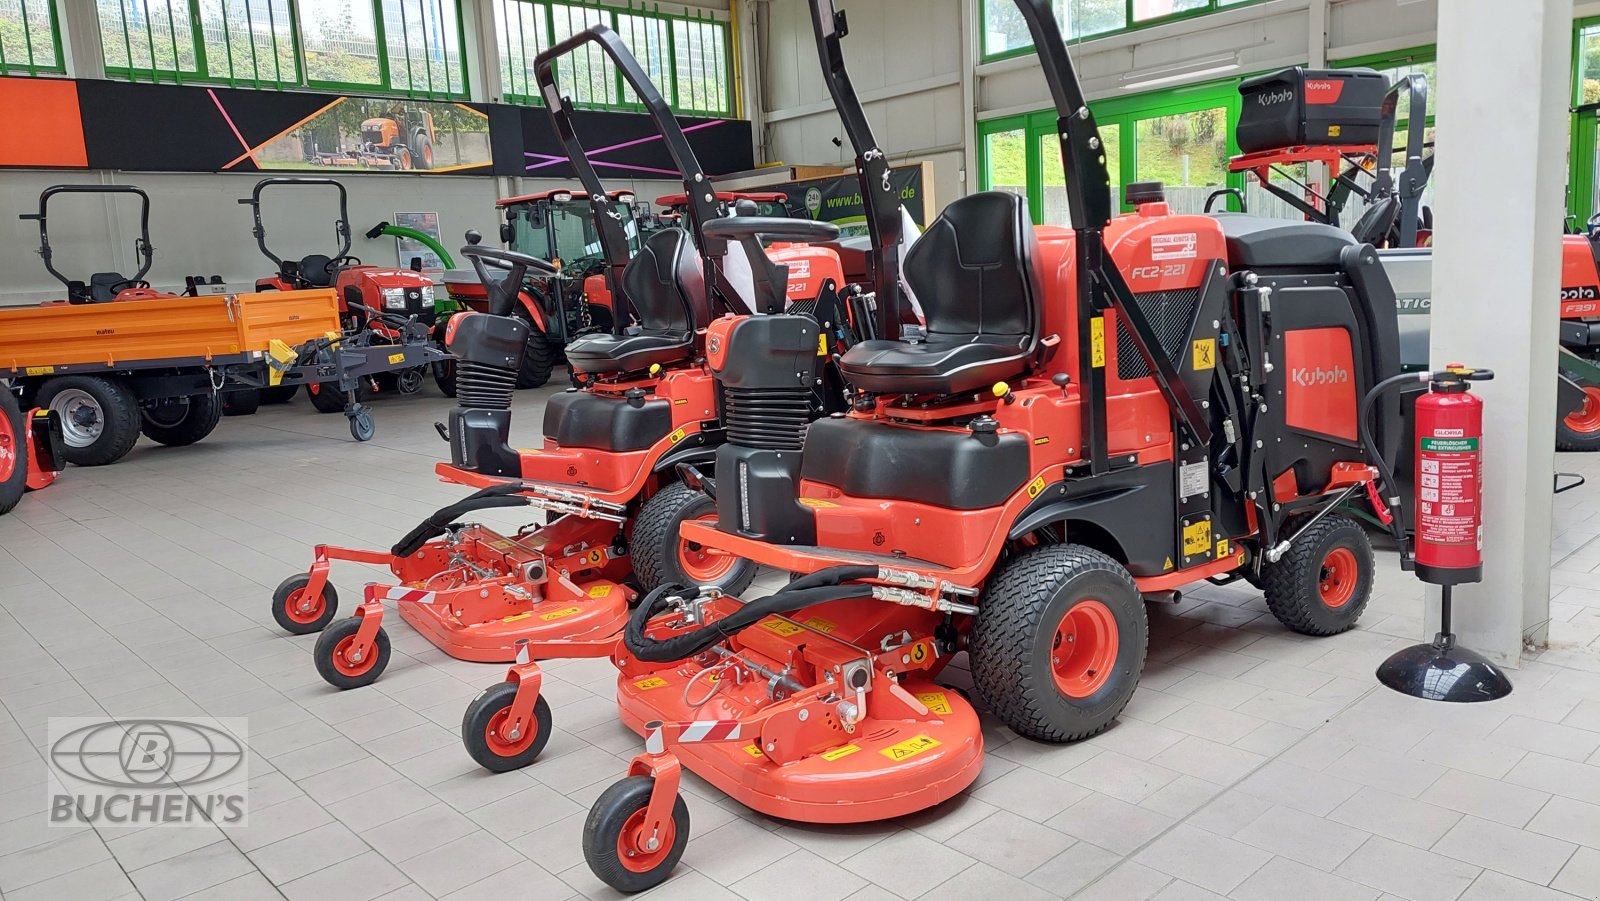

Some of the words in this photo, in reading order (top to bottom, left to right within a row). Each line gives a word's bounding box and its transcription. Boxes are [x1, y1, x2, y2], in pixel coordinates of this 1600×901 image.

[1308, 82, 1331, 90] Kubota
[1258, 89, 1293, 106] Kubota
[1132, 264, 1186, 279] FC2-221
[1292, 365, 1348, 387] Kubota
